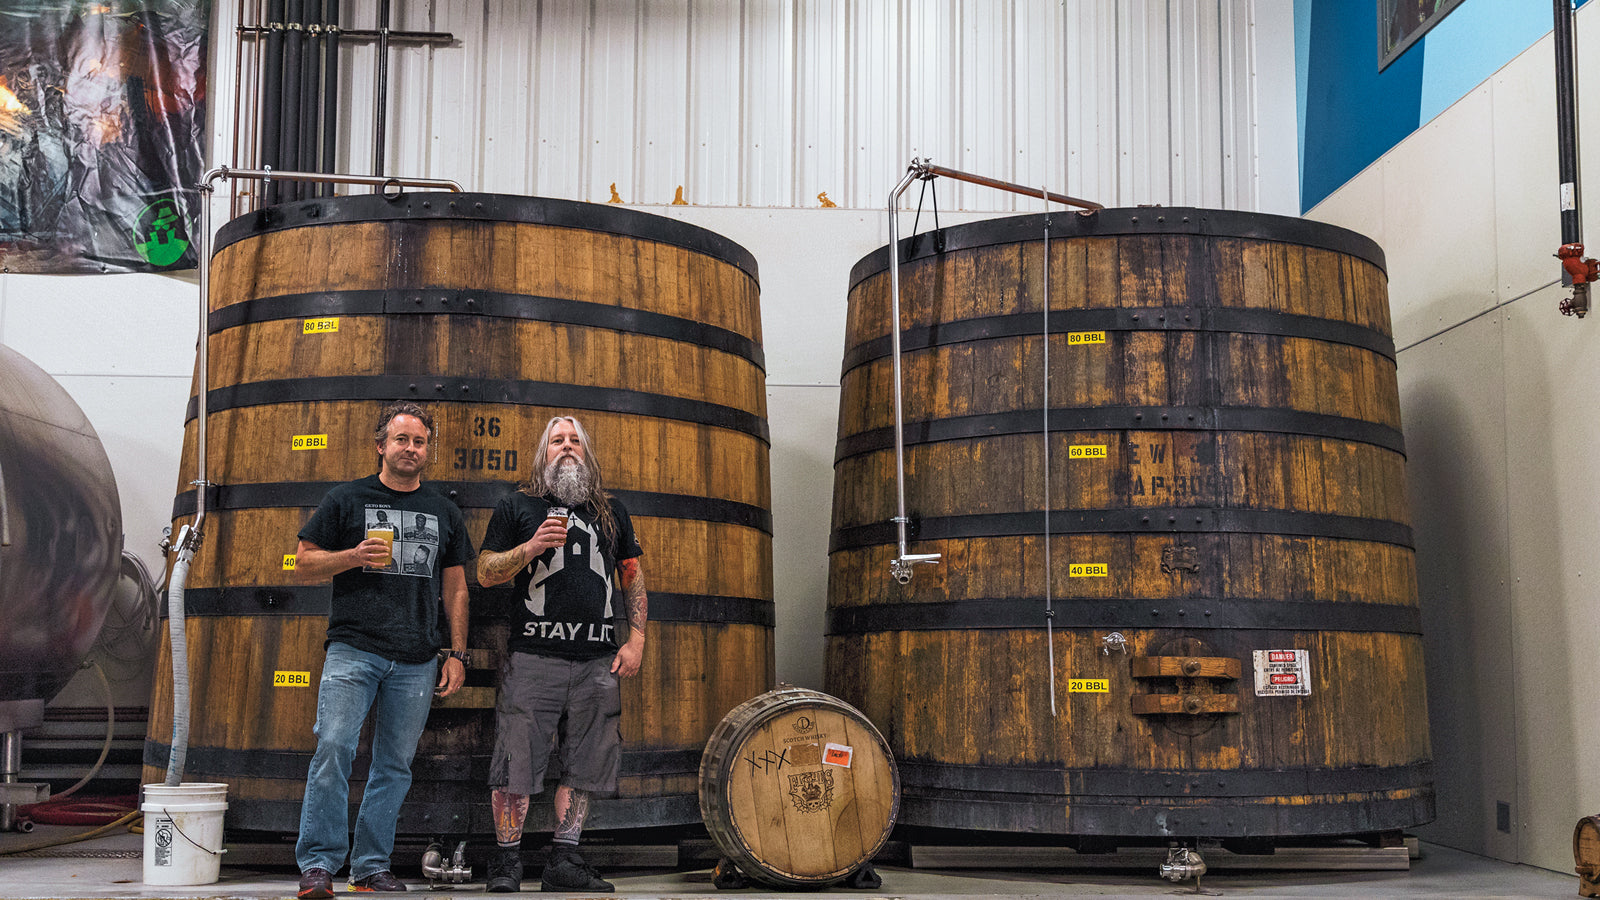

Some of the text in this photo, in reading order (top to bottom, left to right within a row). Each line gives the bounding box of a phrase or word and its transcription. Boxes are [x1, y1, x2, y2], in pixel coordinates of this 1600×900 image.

[304, 321, 337, 331] 80 BBL
[1070, 333, 1104, 342] 80 BBL
[473, 416, 501, 437] 36
[293, 437, 326, 447] 60 BBL
[1071, 447, 1106, 456] 60 BBL
[454, 447, 518, 471] 3050
[284, 557, 295, 567] 40
[1071, 566, 1107, 575] 40 BBL
[523, 621, 582, 640] STAY
[275, 674, 309, 684] 20 BBL
[1071, 681, 1107, 690] 20 BBL
[783, 733, 827, 744] SCOTCH WHISKY
